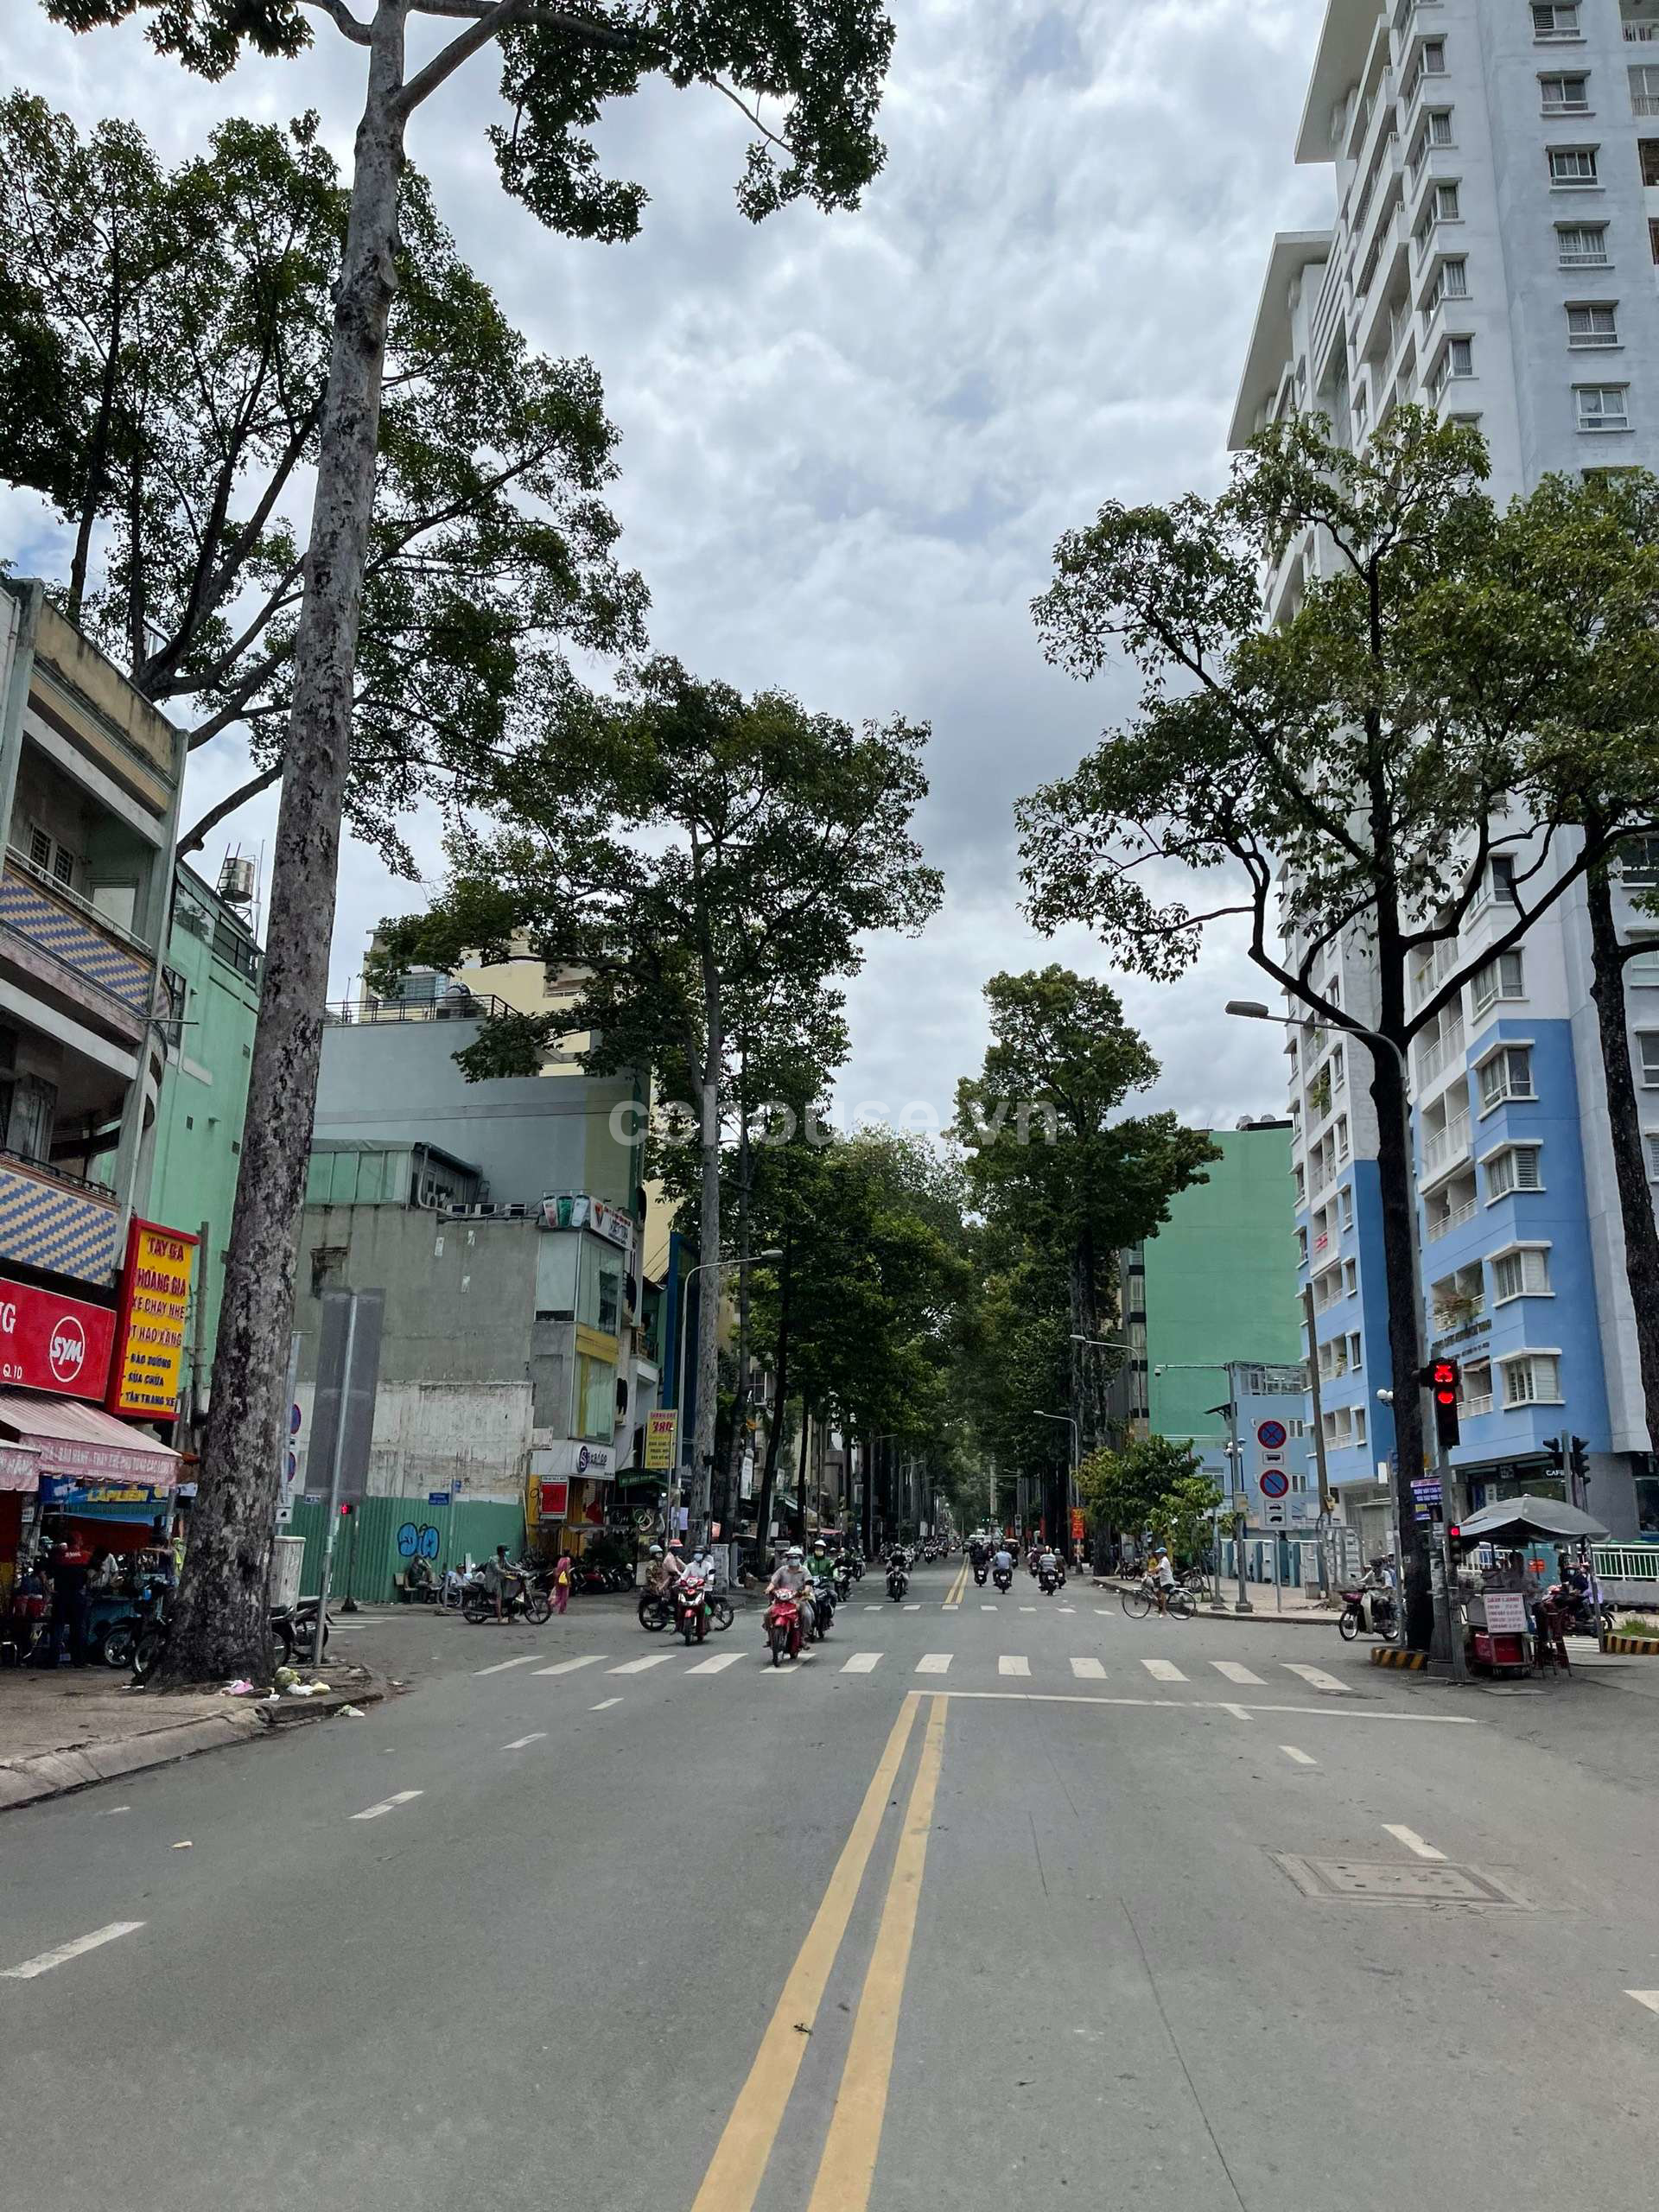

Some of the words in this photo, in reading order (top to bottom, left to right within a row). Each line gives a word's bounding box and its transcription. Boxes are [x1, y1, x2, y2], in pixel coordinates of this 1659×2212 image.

[148, 1236, 168, 1258] TAY
[168, 1243, 184, 1262] GA
[171, 1275, 186, 1297] GIA
[132, 1296, 143, 1310] XE
[51, 1336, 83, 1365] SYM
